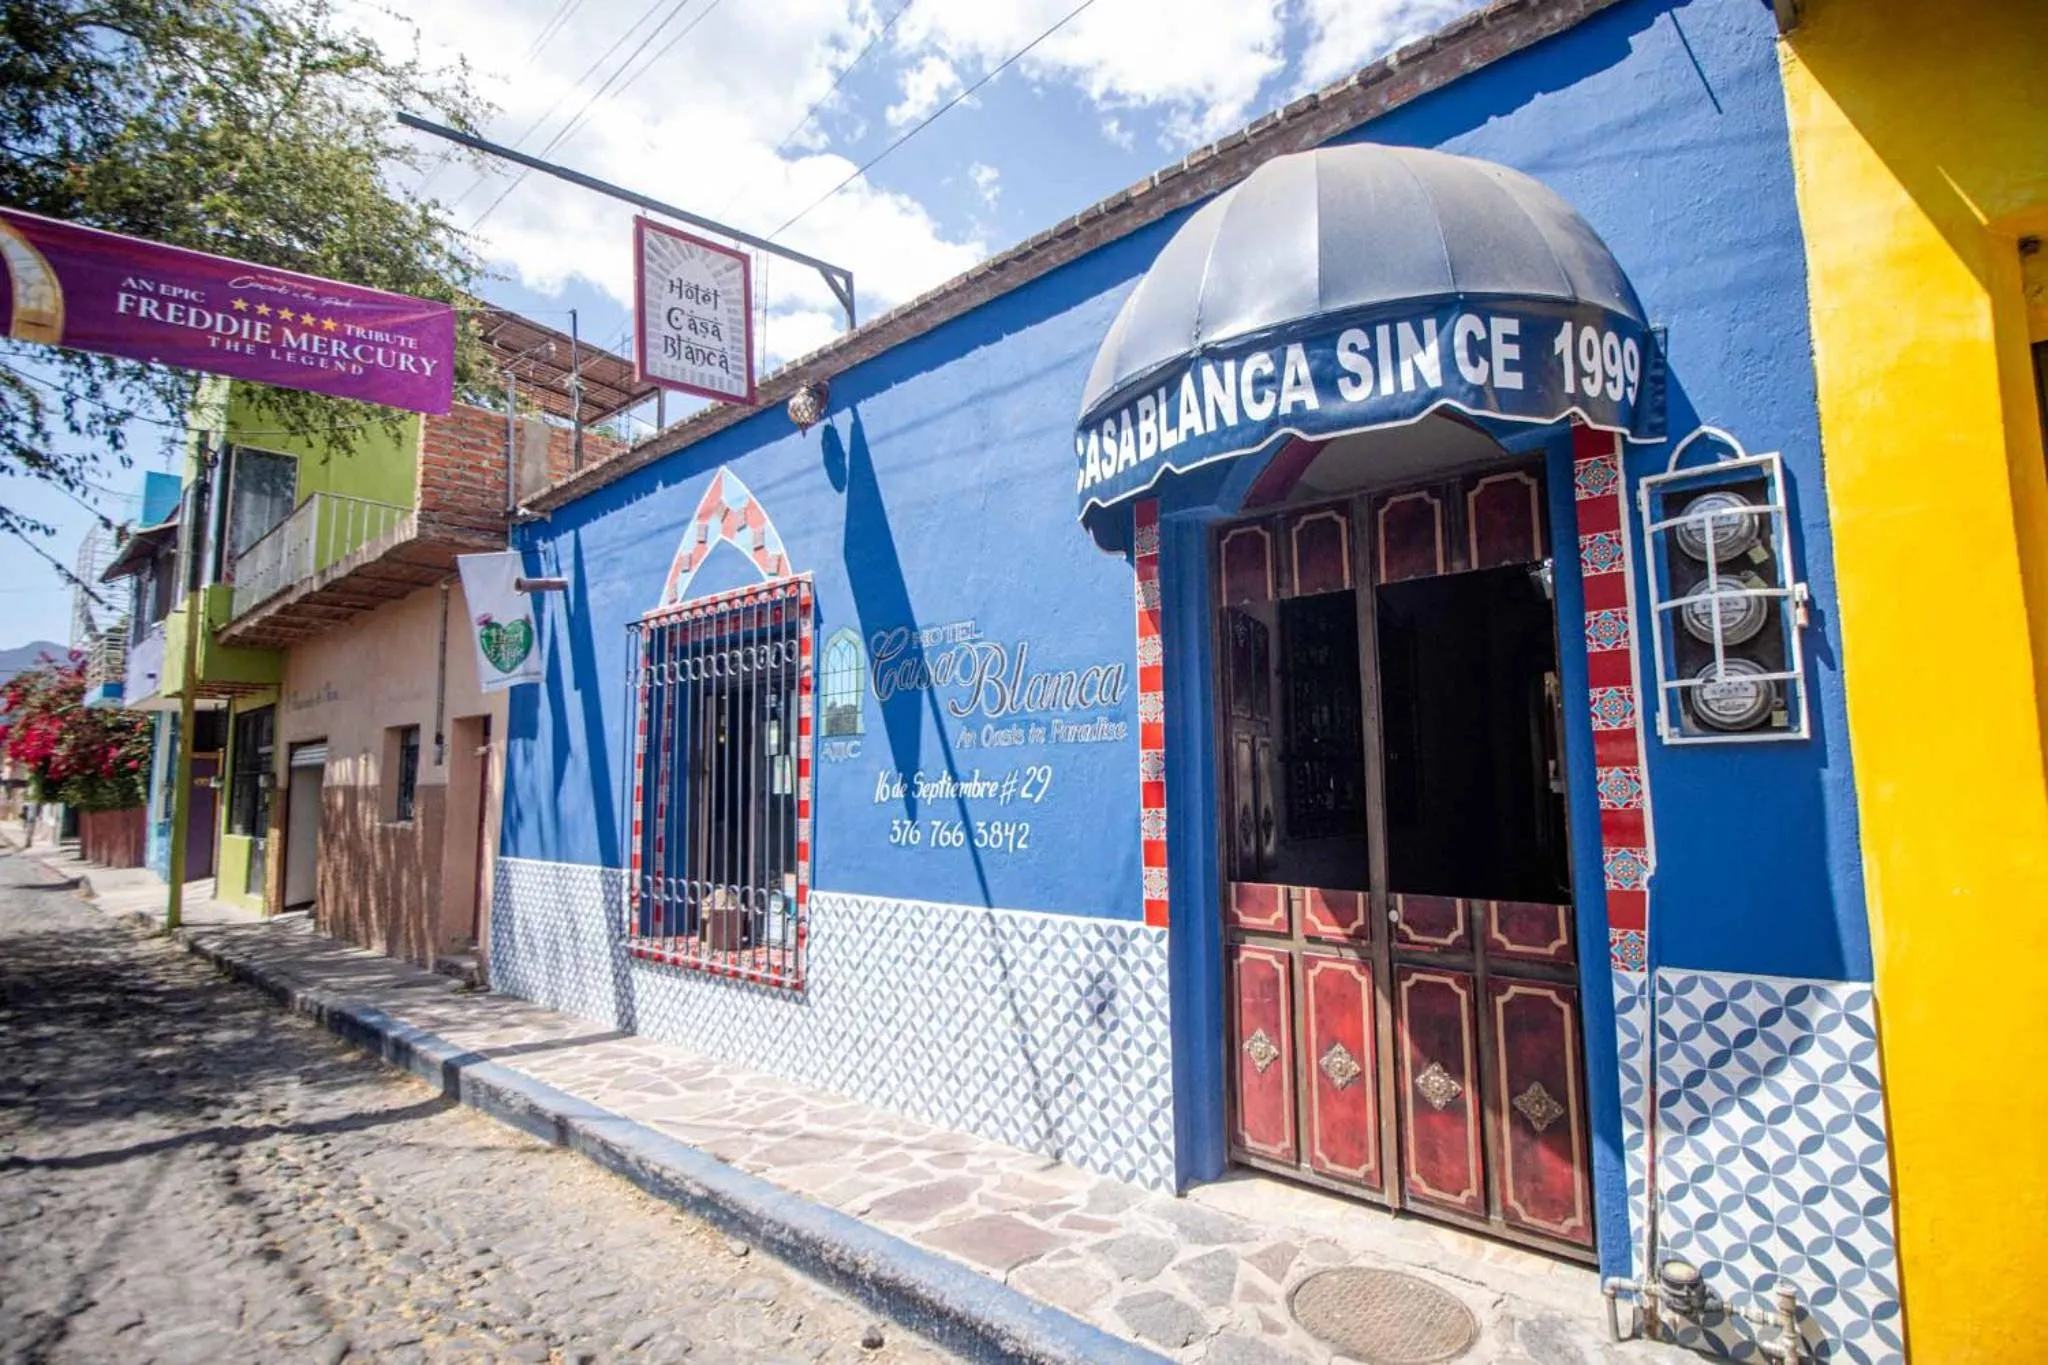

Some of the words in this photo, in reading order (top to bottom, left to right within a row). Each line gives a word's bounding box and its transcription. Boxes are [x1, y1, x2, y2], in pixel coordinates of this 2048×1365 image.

[121, 276, 156, 292] AN
[159, 283, 206, 303] EPIC
[344, 323, 418, 349] TRIBUTE
[116, 291, 272, 344] FREDDIE
[280, 327, 438, 377] MERCURY
[208, 335, 256, 355] THE
[271, 348, 364, 375] LEGEND
[1337, 313, 1523, 402] SINCE
[1553, 320, 1640, 408] 1999
[911, 620, 984, 649] HOTEL
[871, 626, 956, 701] Casa
[948, 641, 1127, 718] Blanca
[1051, 715, 1128, 744] Paradise
[874, 769, 890, 804] 16
[891, 776, 908, 799] de
[911, 768, 999, 806] Septiembre
[1021, 765, 1052, 803] 29
[889, 819, 921, 846] 376
[930, 820, 965, 848] 766
[973, 820, 1031, 852] 3842
